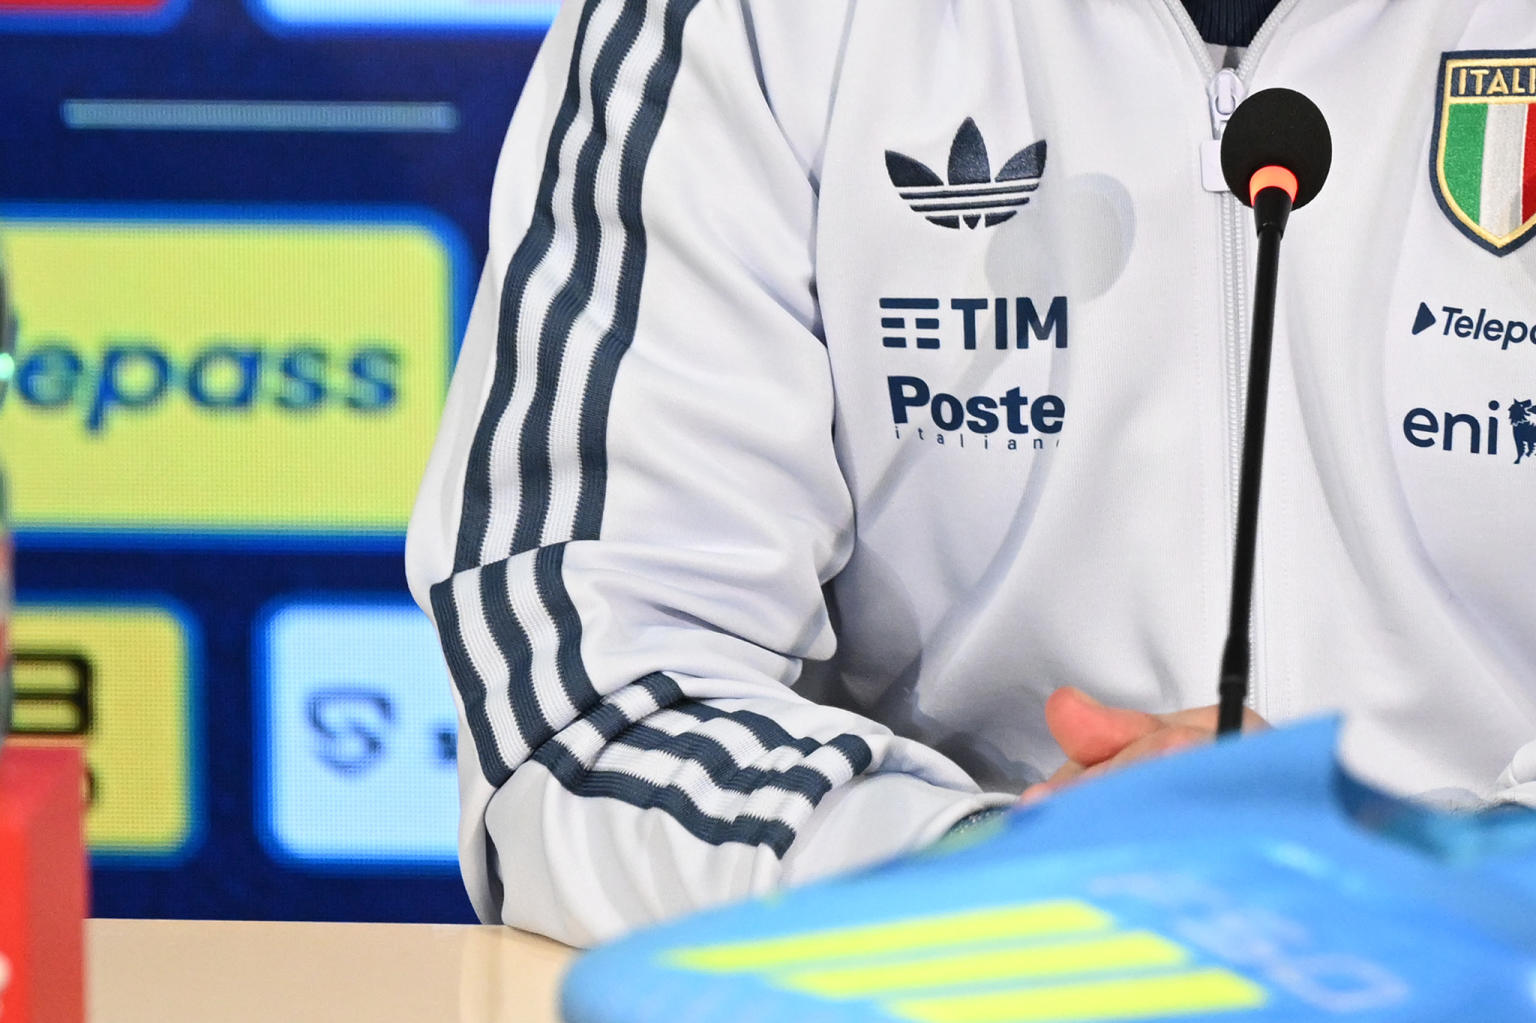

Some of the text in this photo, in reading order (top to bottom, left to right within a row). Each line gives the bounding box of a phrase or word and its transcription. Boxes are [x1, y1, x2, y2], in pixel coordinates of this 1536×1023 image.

[950, 295, 1069, 351] TIM
[886, 375, 1066, 435] Poste
[1402, 399, 1500, 456] eni
[893, 424, 1061, 451] italian
